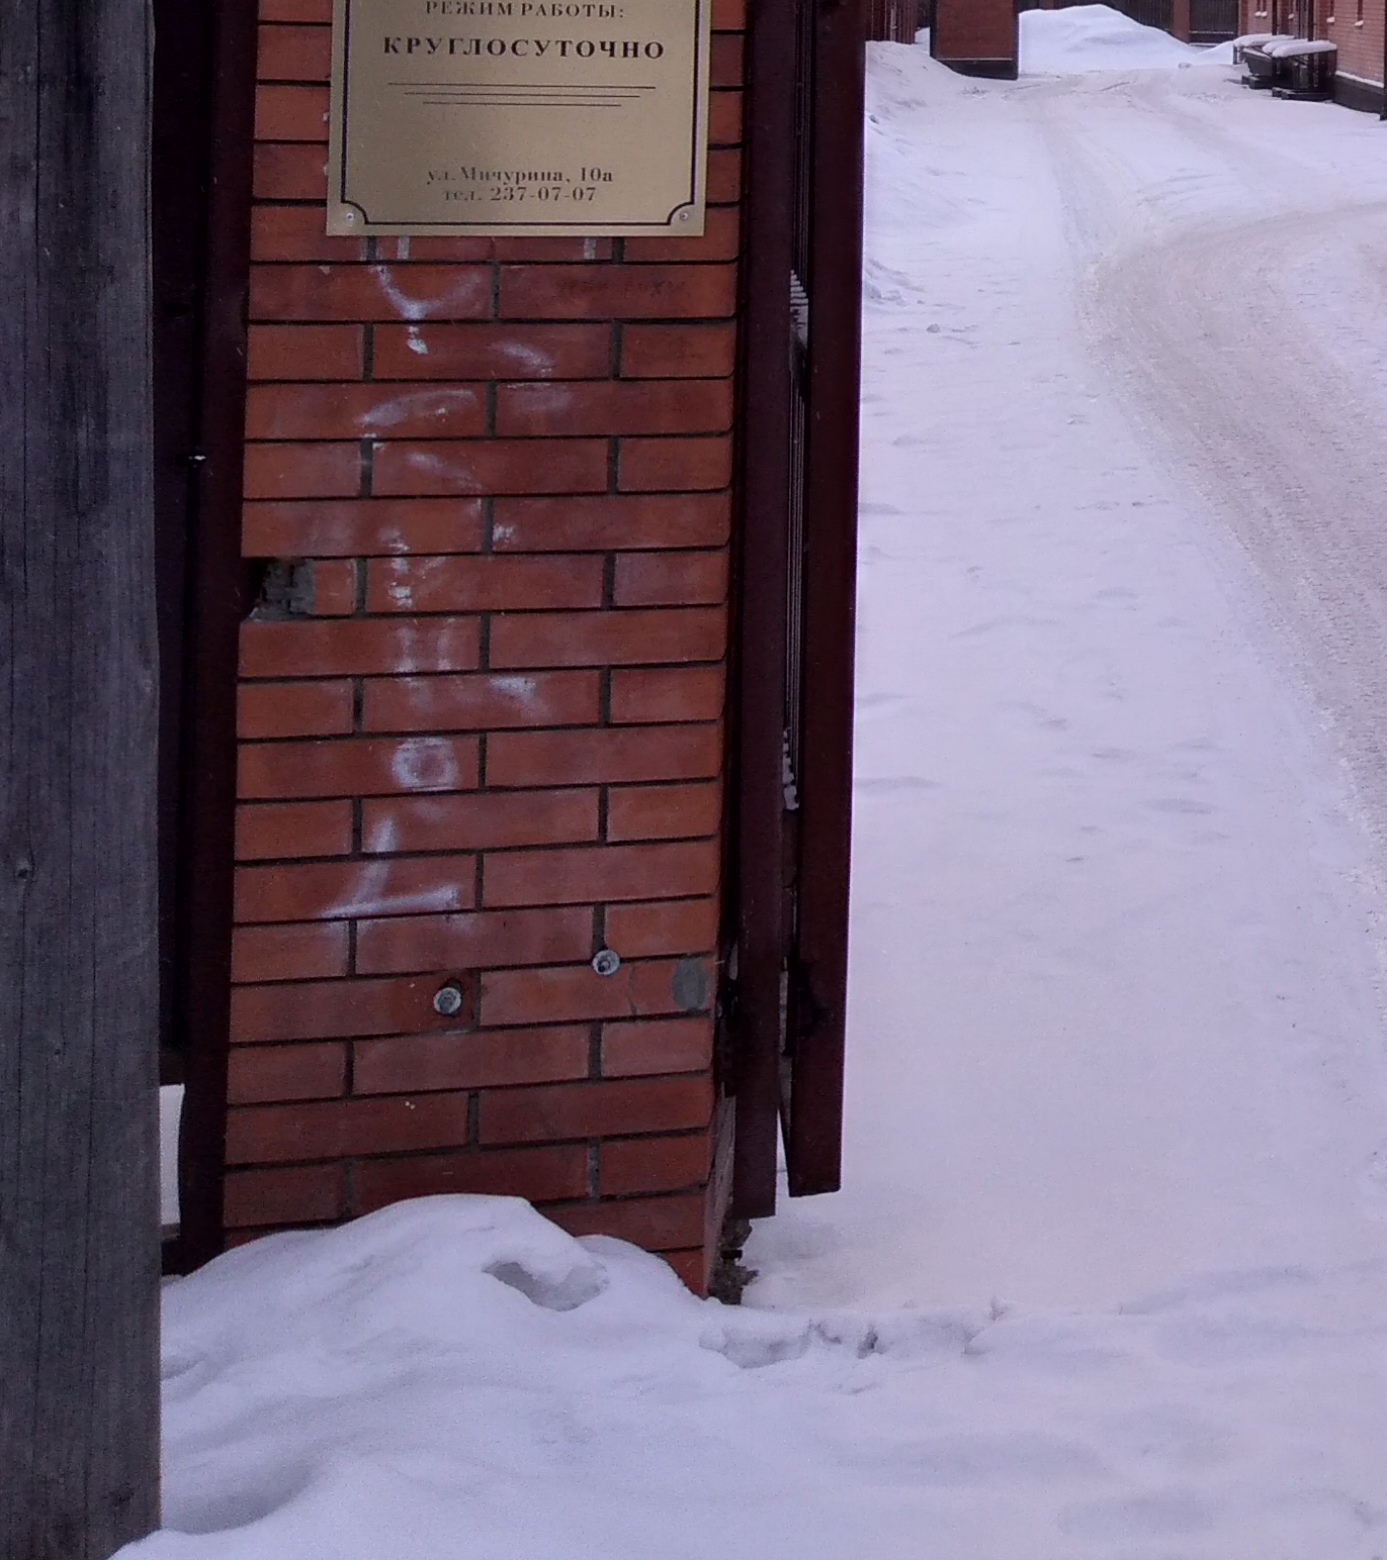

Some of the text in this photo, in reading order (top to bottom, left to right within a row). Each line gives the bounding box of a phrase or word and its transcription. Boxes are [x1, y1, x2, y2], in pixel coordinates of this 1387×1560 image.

[426, 1, 624, 18] РЕЖИМ РАБОТЫ:
[384, 37, 664, 59] КРУГЛОСУТОЧНО
[426, 167, 613, 185] ул. Мичурина, 10а
[443, 187, 597, 201] тел. 237-07-07
